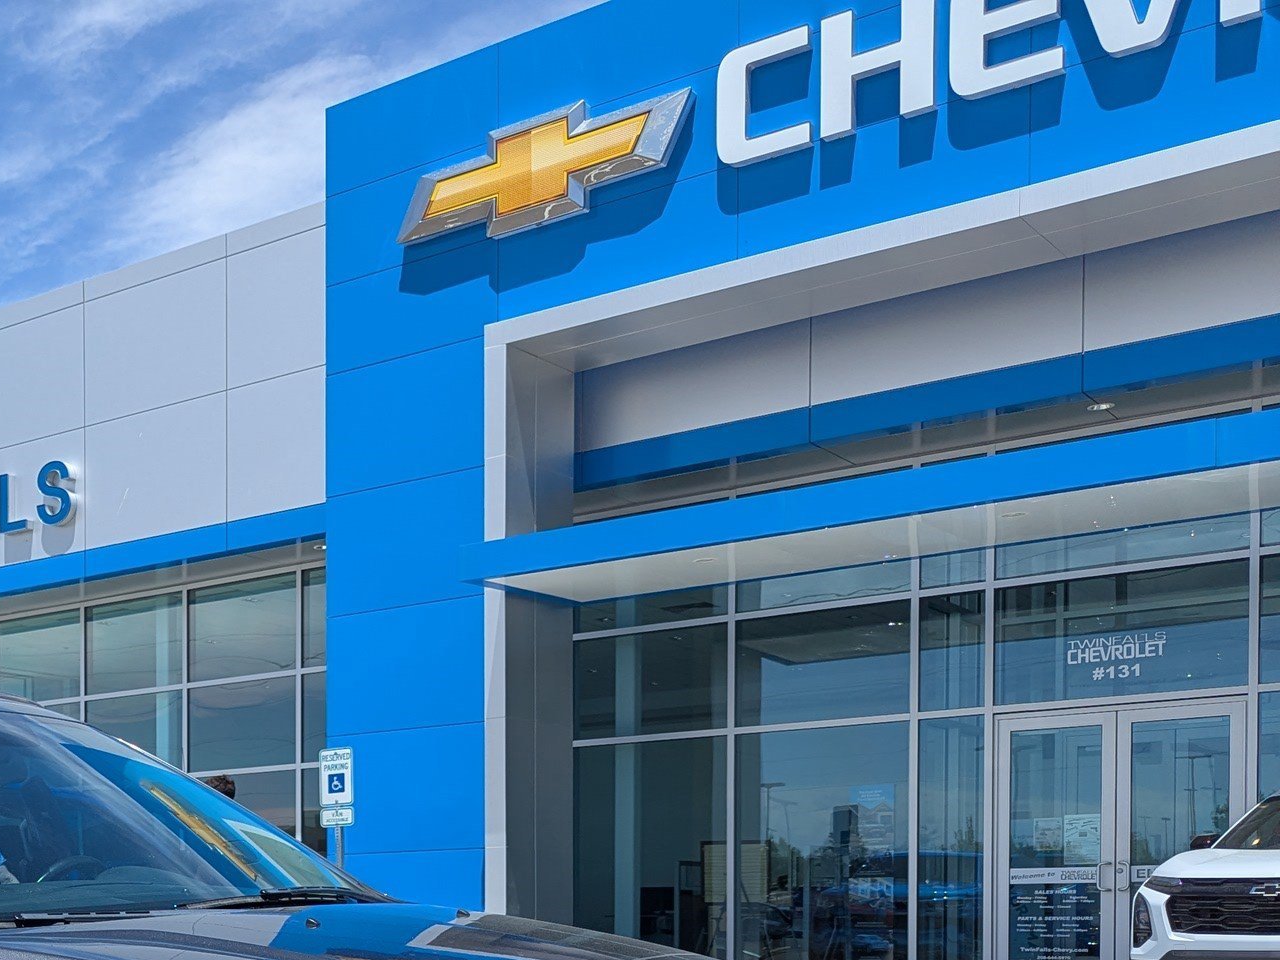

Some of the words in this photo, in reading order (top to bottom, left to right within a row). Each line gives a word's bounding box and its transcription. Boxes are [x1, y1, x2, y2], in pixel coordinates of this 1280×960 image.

[717, 0, 1261, 166] CHE
[1067, 631, 1166, 650] TWINFALLS
[1067, 640, 1166, 665] CHEVROLET
[1092, 663, 1141, 681] #131
[322, 753, 350, 761] RESERVED
[323, 762, 349, 772] PARKING
[1011, 872, 1046, 881] Welcome
